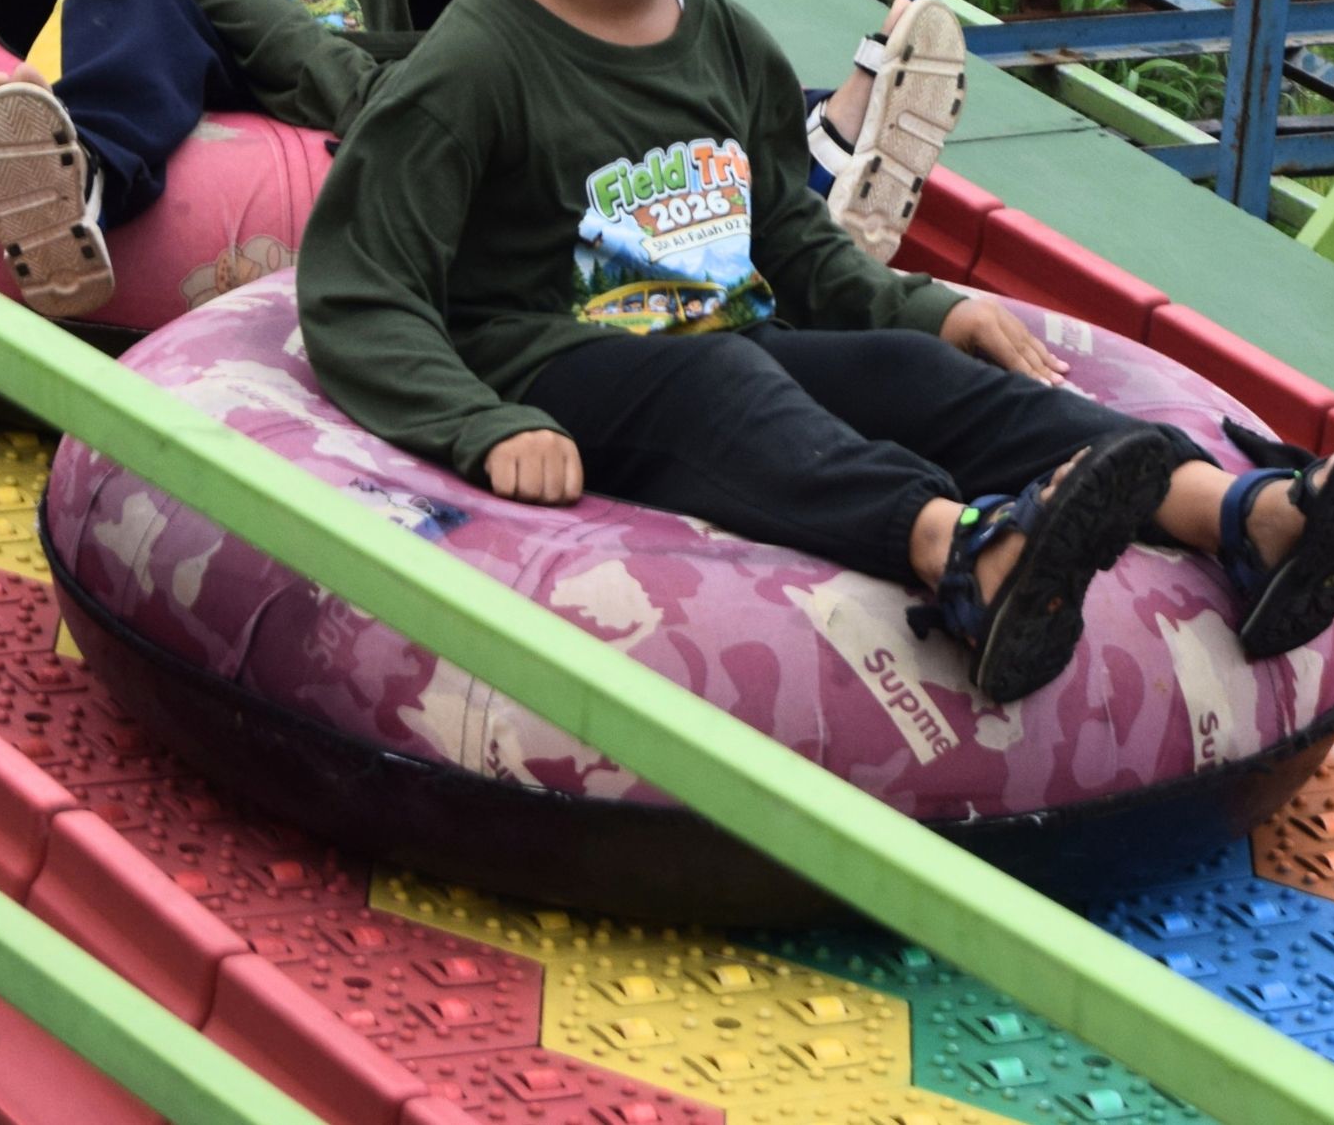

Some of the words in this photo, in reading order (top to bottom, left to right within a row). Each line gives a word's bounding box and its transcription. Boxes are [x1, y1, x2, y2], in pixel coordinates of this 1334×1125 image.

[593, 149, 688, 218] Field
[693, 144, 753, 186] Tri
[648, 190, 731, 231] 2026
[672, 224, 723, 246] Al-Falah
[863, 647, 953, 757] Supme
